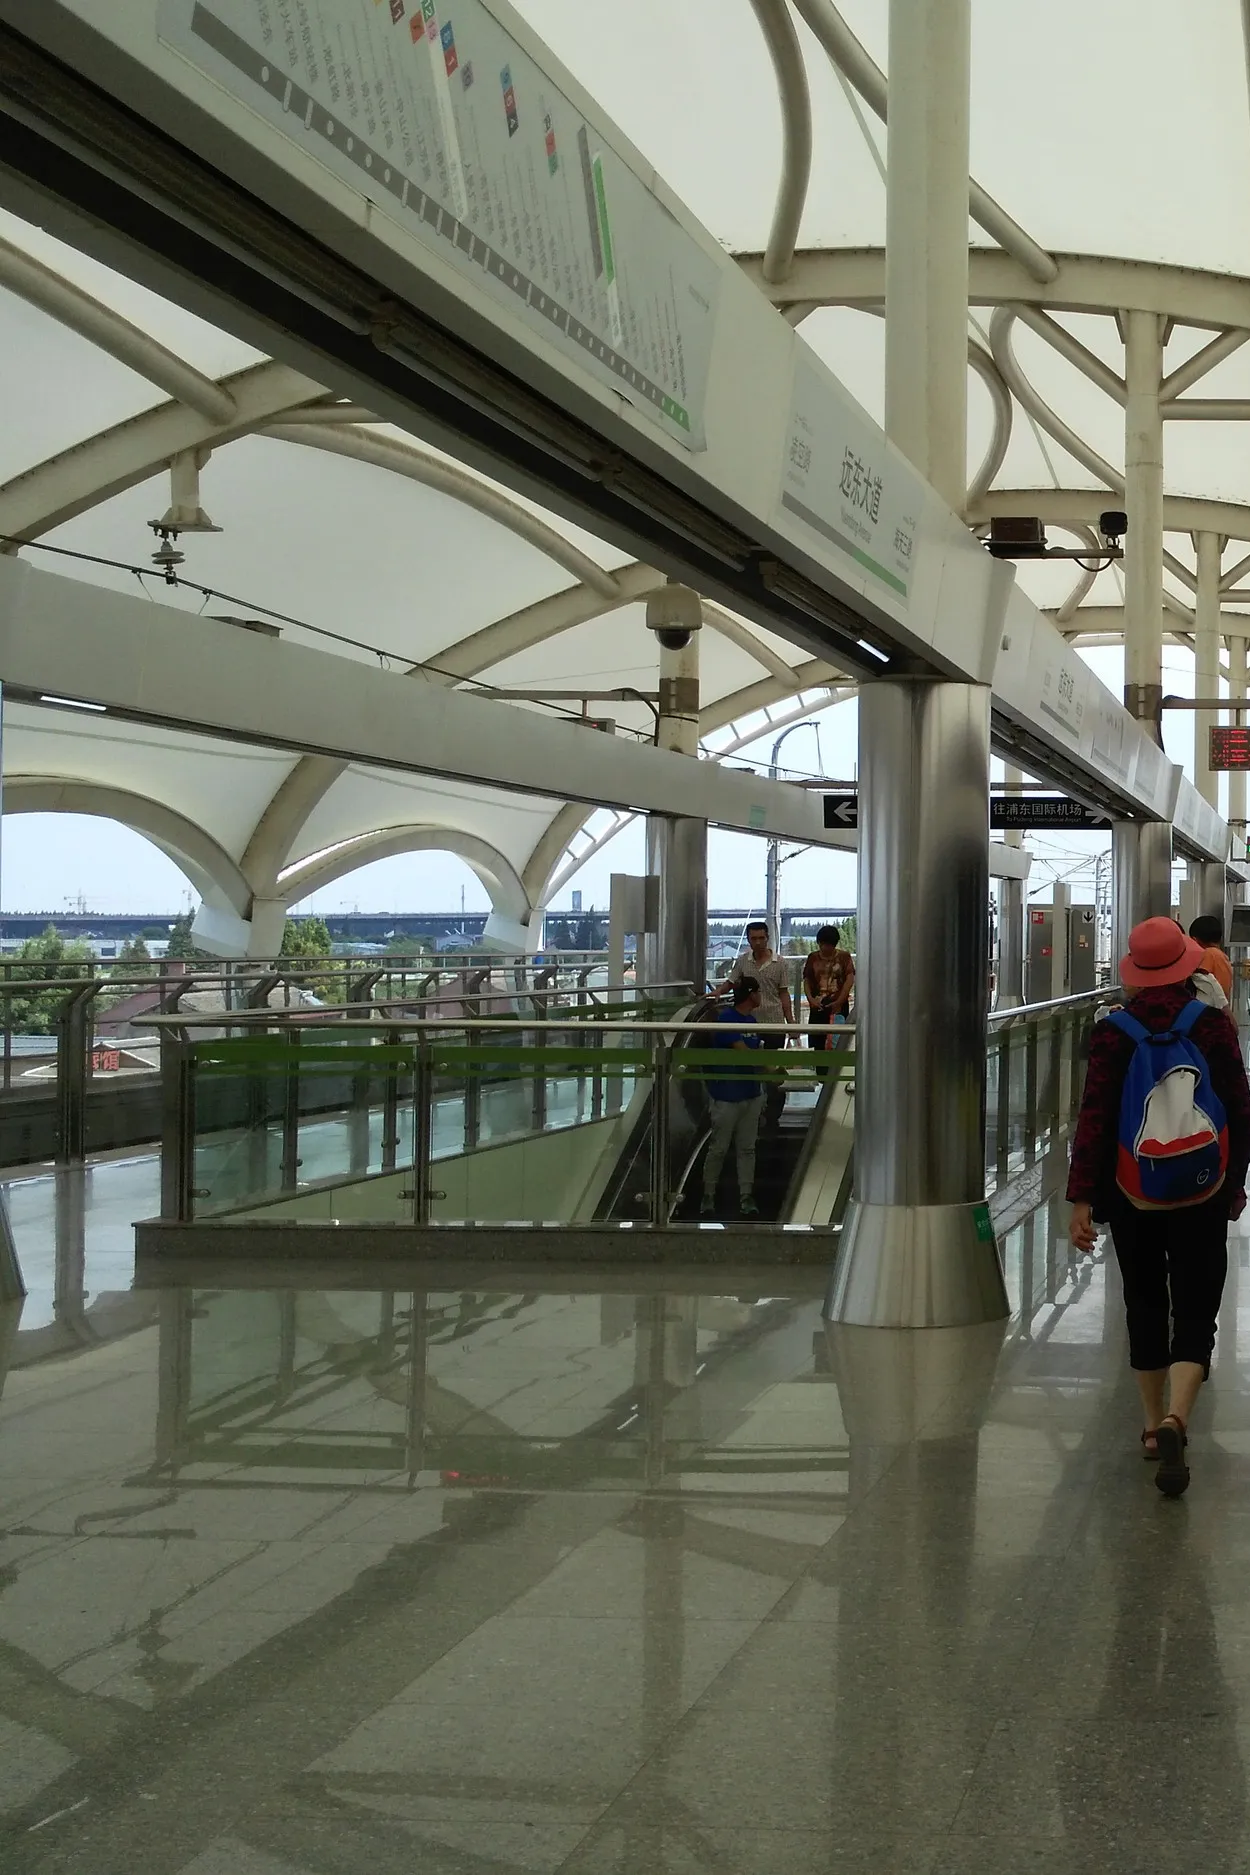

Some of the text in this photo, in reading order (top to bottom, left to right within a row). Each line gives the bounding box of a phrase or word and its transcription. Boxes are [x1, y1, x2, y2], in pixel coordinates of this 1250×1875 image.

[838, 445, 884, 525] 远东大道
[993, 803, 1082, 816] 往浦东国际机场
